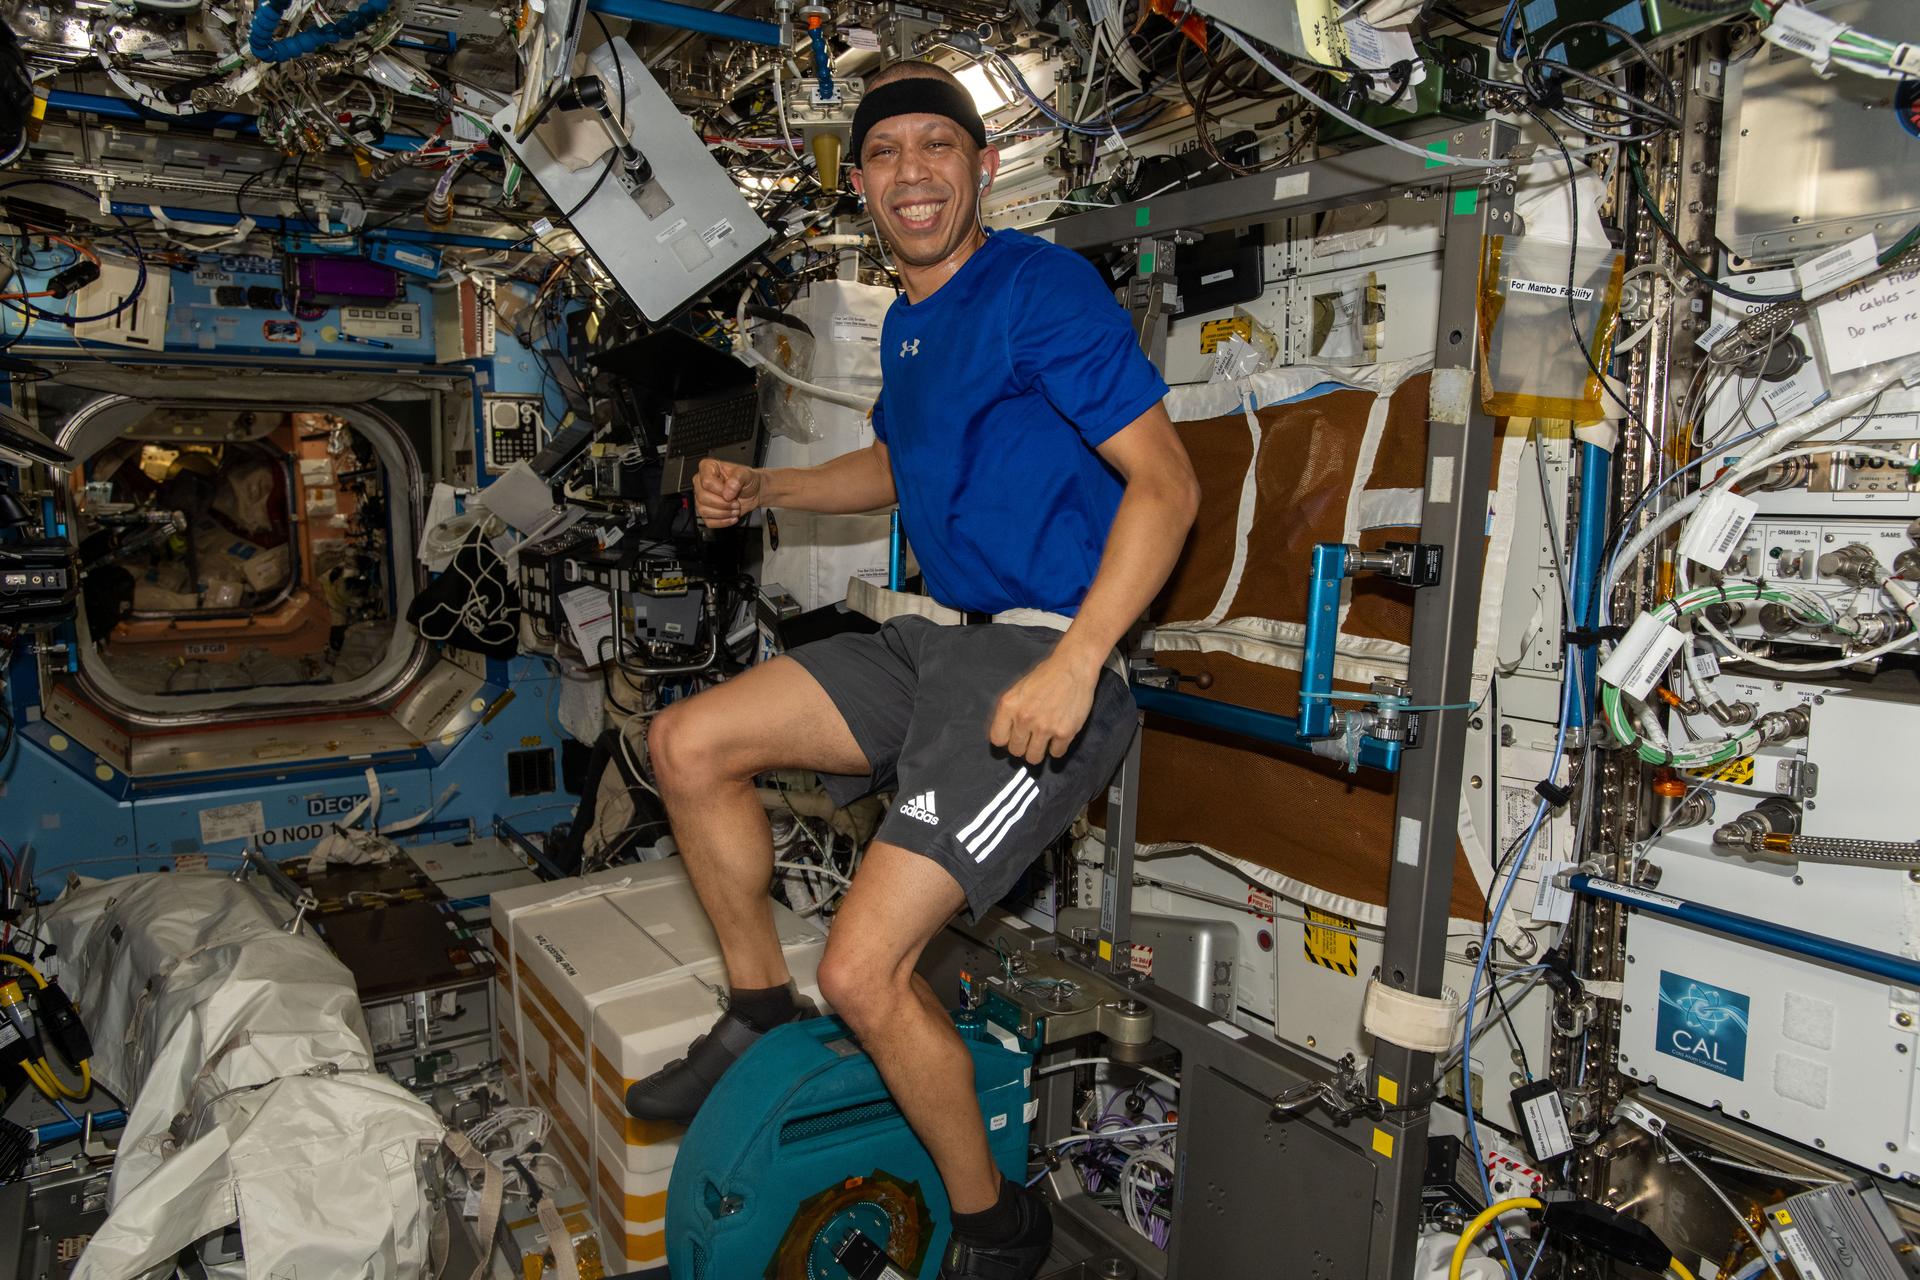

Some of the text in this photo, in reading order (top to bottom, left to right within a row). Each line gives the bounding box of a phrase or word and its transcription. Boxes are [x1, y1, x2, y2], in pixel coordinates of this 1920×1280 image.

[1511, 281, 1593, 299] For Mambo Facility
[1859, 292, 1900, 312] cables
[1847, 326, 1866, 339] Do
[1872, 316, 1898, 332] not
[310, 795, 366, 815] DECK
[900, 804, 939, 825] adidas
[283, 824, 323, 842] NOD
[1626, 887, 1650, 899] MOVE
[1672, 1030, 1728, 1066] CAL
[1671, 1049, 1727, 1073] Cold Atom Laboratory
